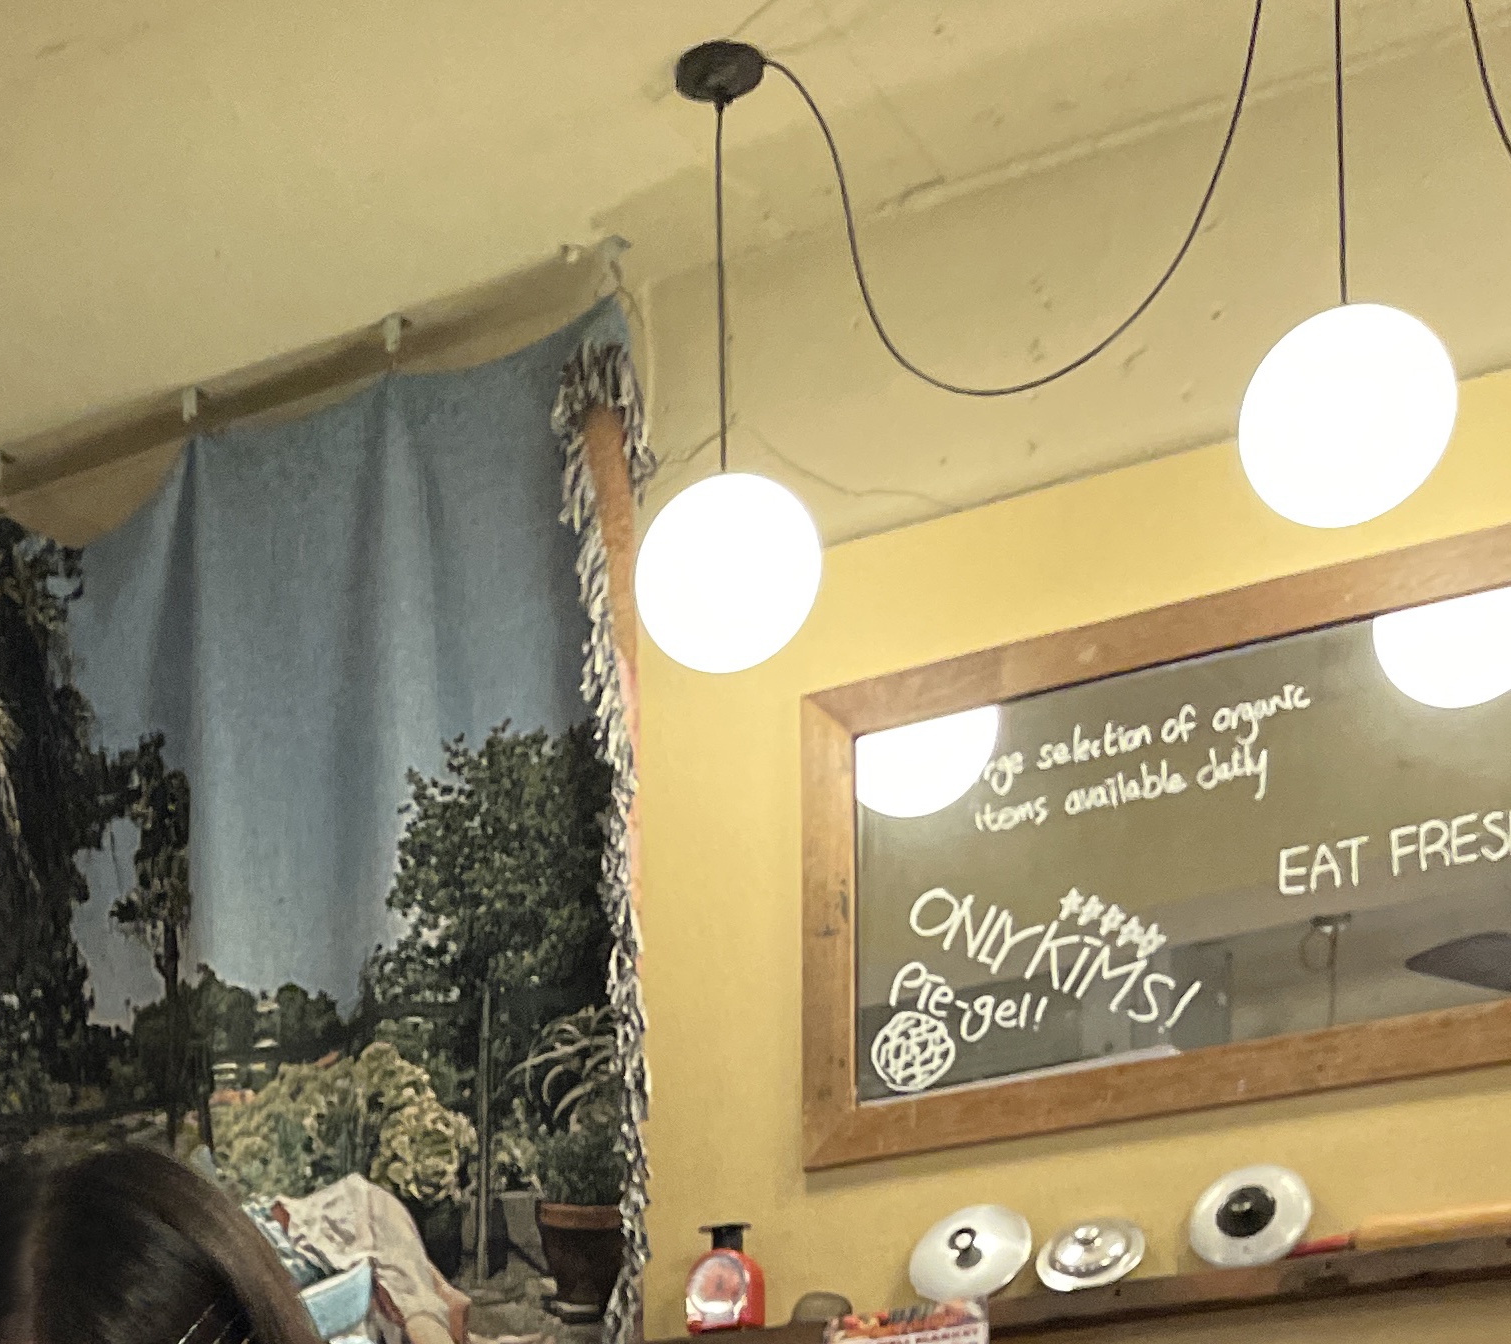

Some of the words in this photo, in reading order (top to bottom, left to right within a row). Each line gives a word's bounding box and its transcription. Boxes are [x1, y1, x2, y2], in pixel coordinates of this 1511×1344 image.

[1160, 703, 1197, 744] of
[1211, 684, 1312, 745] organic
[1064, 758, 1188, 816] available
[1196, 744, 1268, 801] daily
[1278, 835, 1370, 895] EAT
[1389, 811, 1511, 877] FRES
[909, 887, 1046, 975] ONLY
